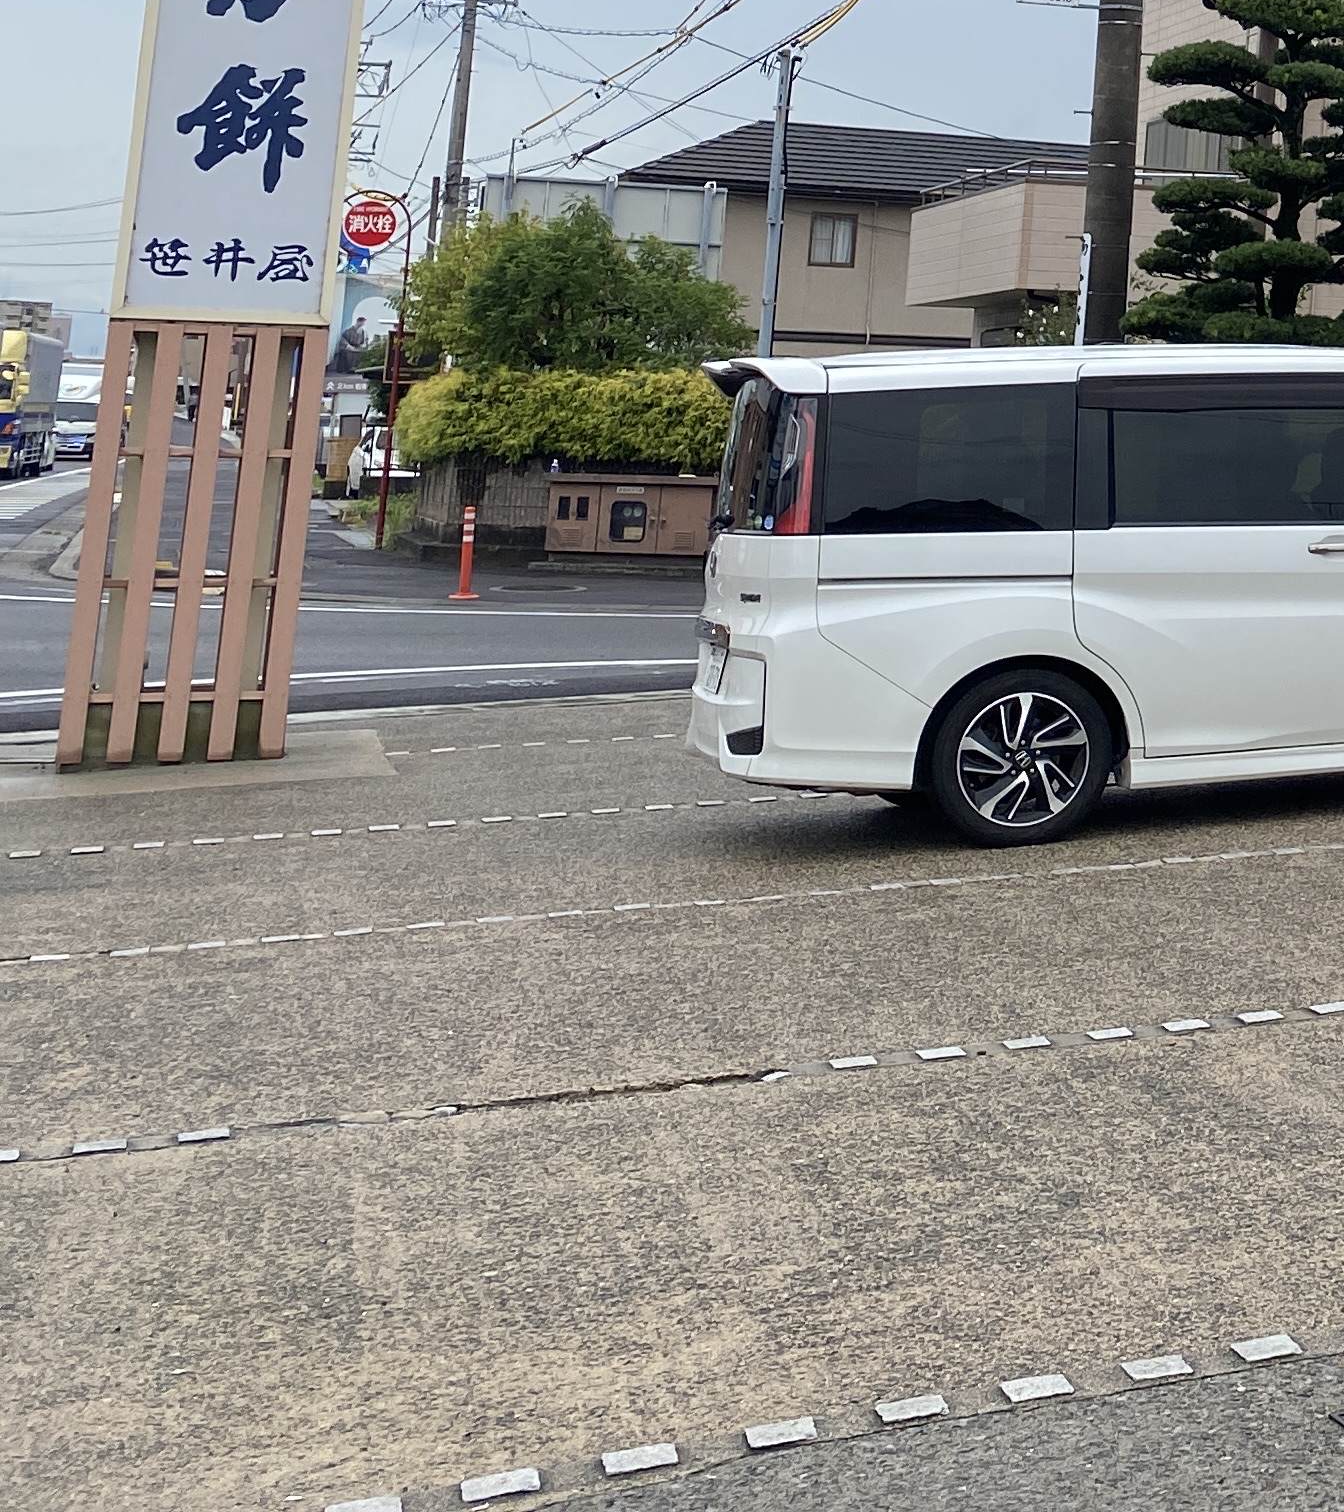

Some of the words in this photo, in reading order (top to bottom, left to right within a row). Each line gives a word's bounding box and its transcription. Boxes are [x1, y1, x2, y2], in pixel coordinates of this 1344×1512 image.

[348, 214, 393, 233] 消火栓
[139, 238, 314, 283] 笹井屋
